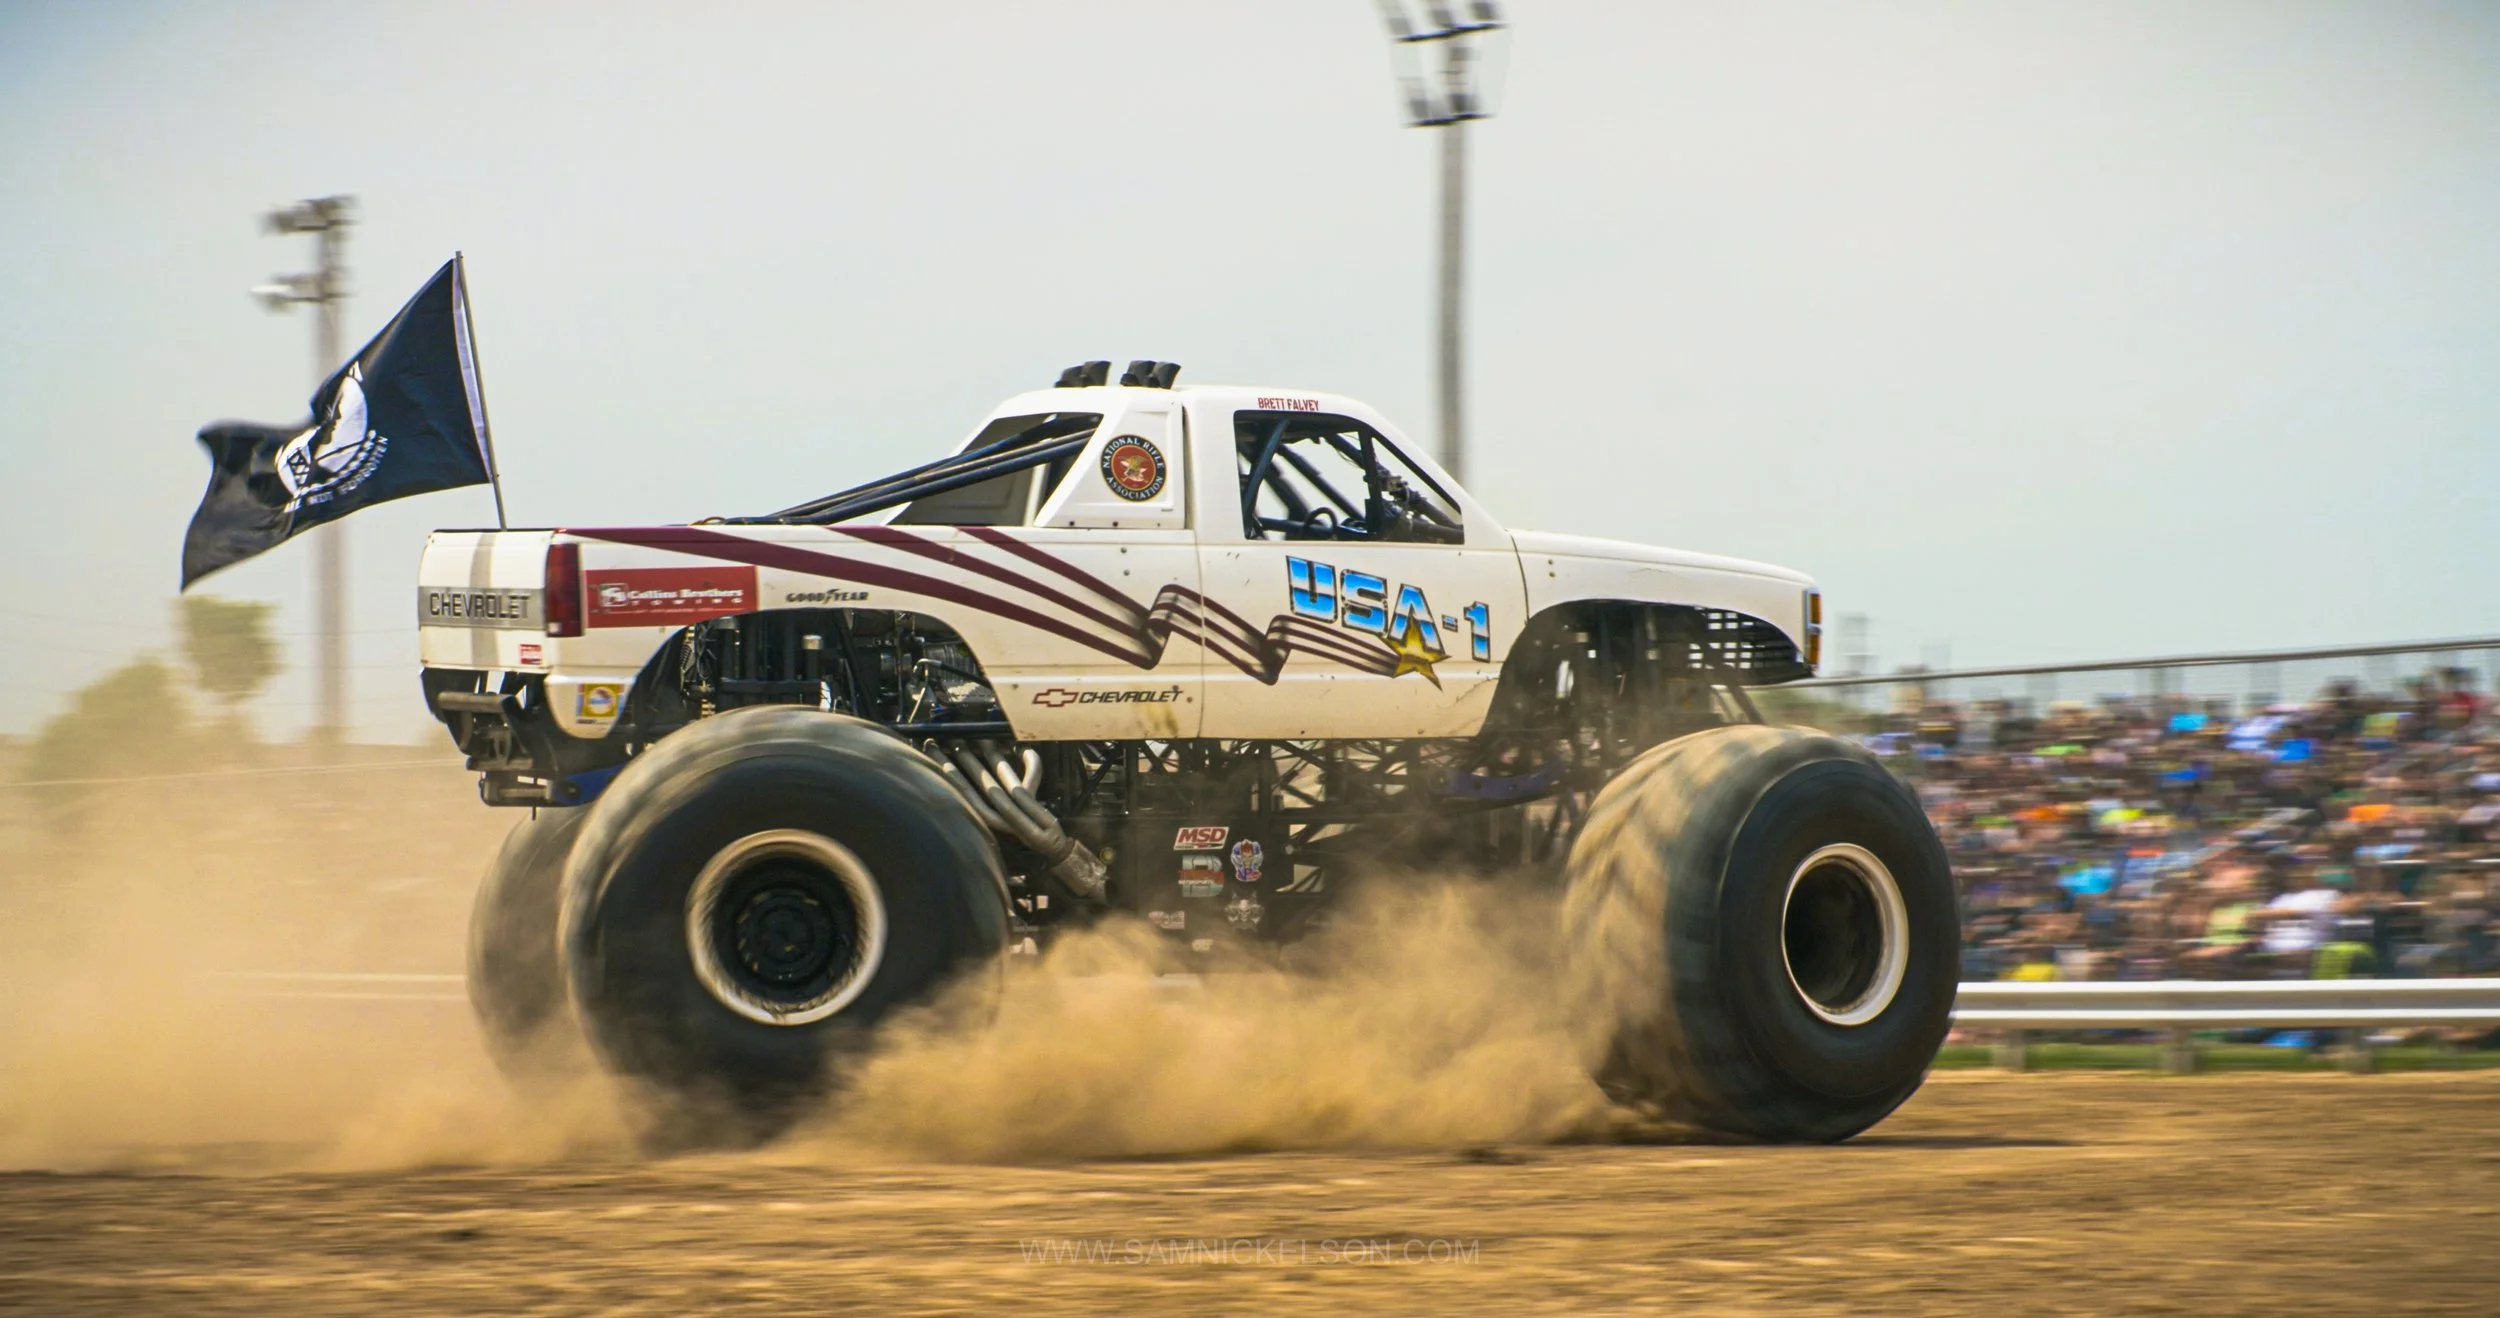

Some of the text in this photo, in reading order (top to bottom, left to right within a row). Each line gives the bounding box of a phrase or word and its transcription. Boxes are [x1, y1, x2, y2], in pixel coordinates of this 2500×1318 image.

[1257, 397, 1319, 411] BRETT FALVEY
[1102, 437, 1165, 469] NATIONAL RIFLE
[1106, 475, 1164, 499] ASSOCIATION
[430, 592, 530, 619] CHEVROLET
[785, 588, 869, 604] GOODYEAR
[1286, 555, 1491, 663] USA-1
[1078, 689, 1184, 704] CHEVROLET
[1179, 828, 1227, 843] MSD
